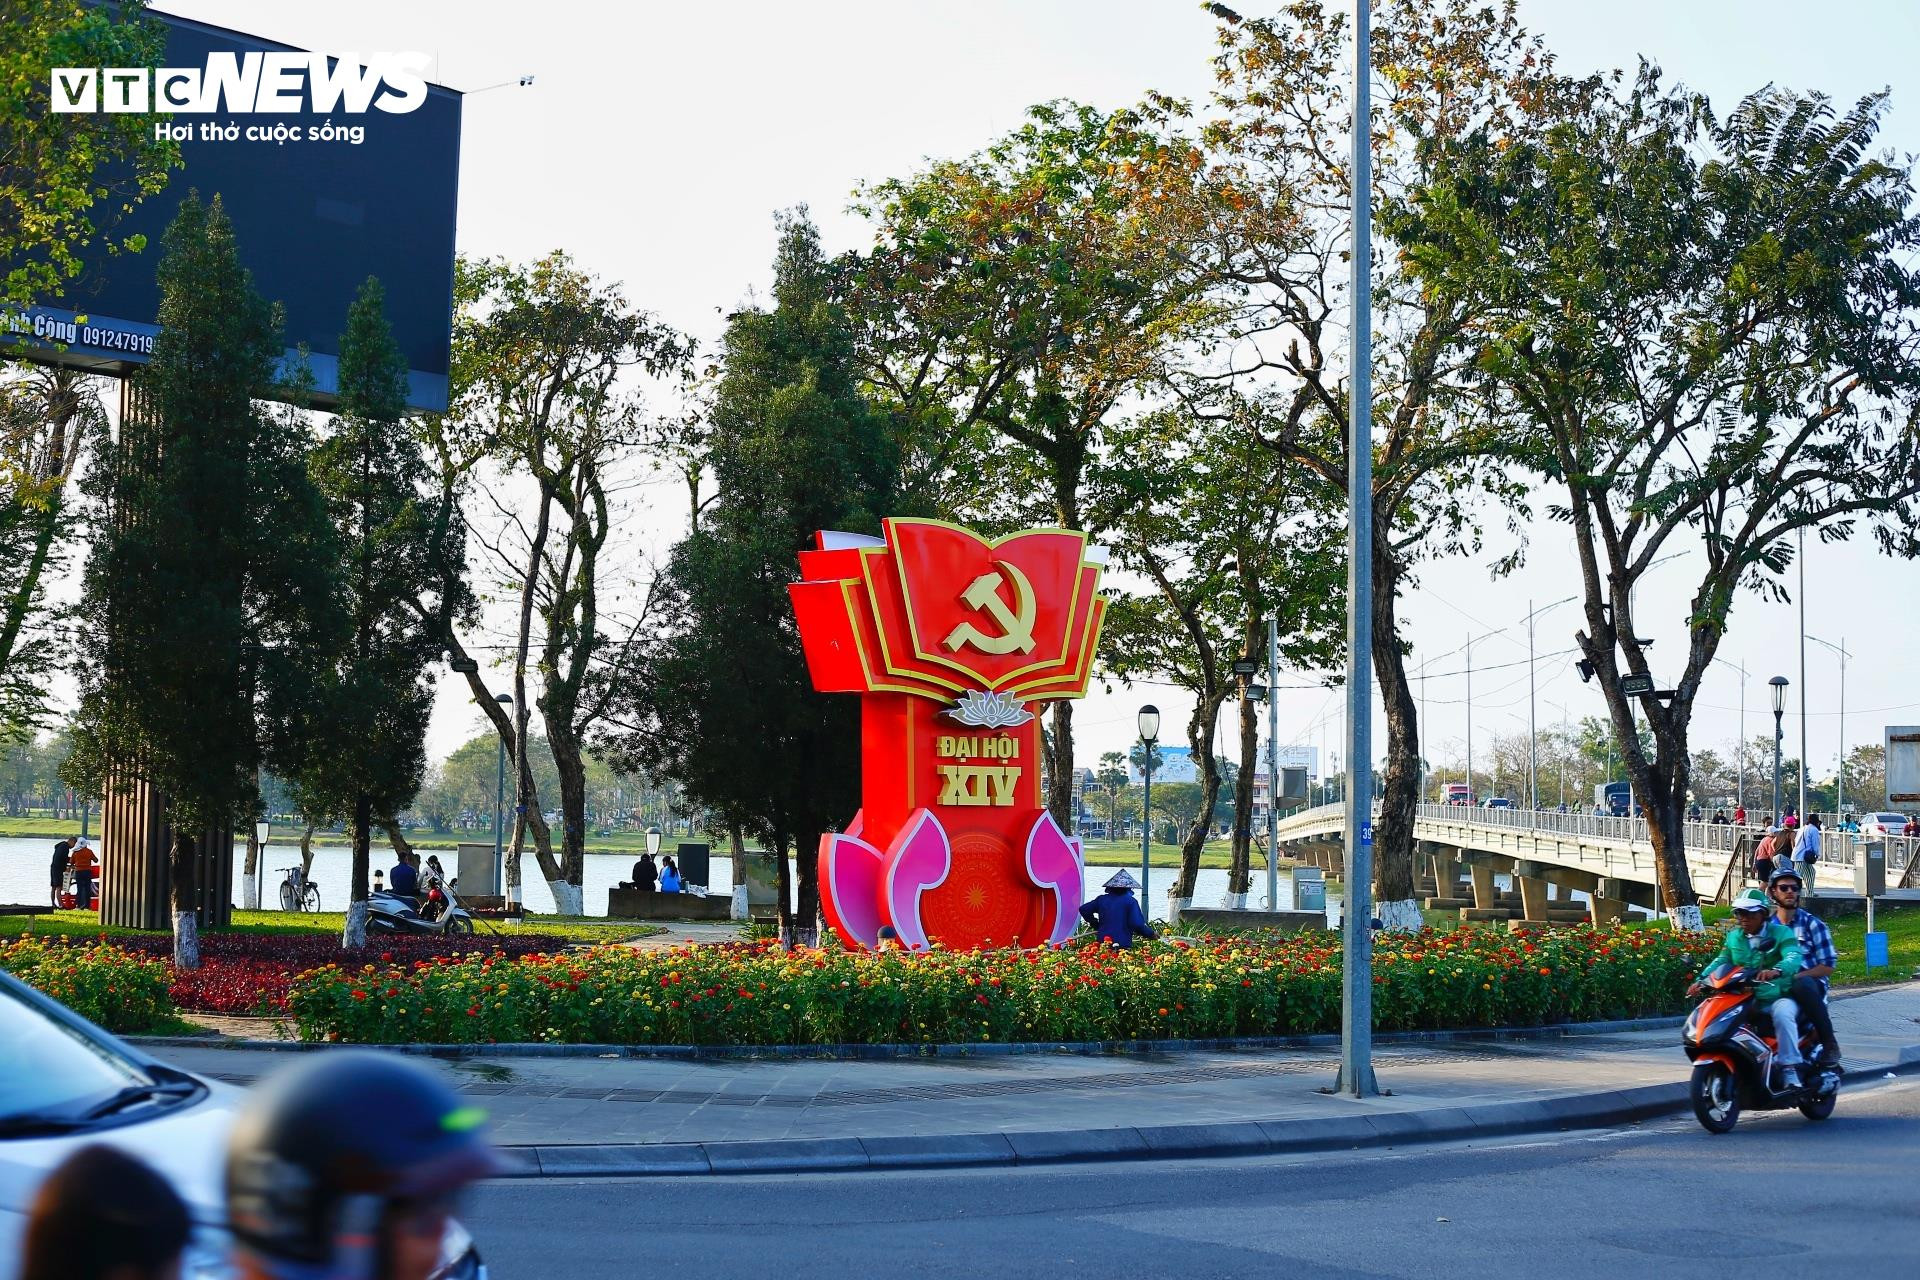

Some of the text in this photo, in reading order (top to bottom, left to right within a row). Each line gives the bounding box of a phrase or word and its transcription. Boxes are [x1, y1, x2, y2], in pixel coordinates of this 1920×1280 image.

[34, 315, 77, 344] Công
[937, 731, 1019, 764] ĐẠI HỘI
[937, 765, 1022, 806] XIV
